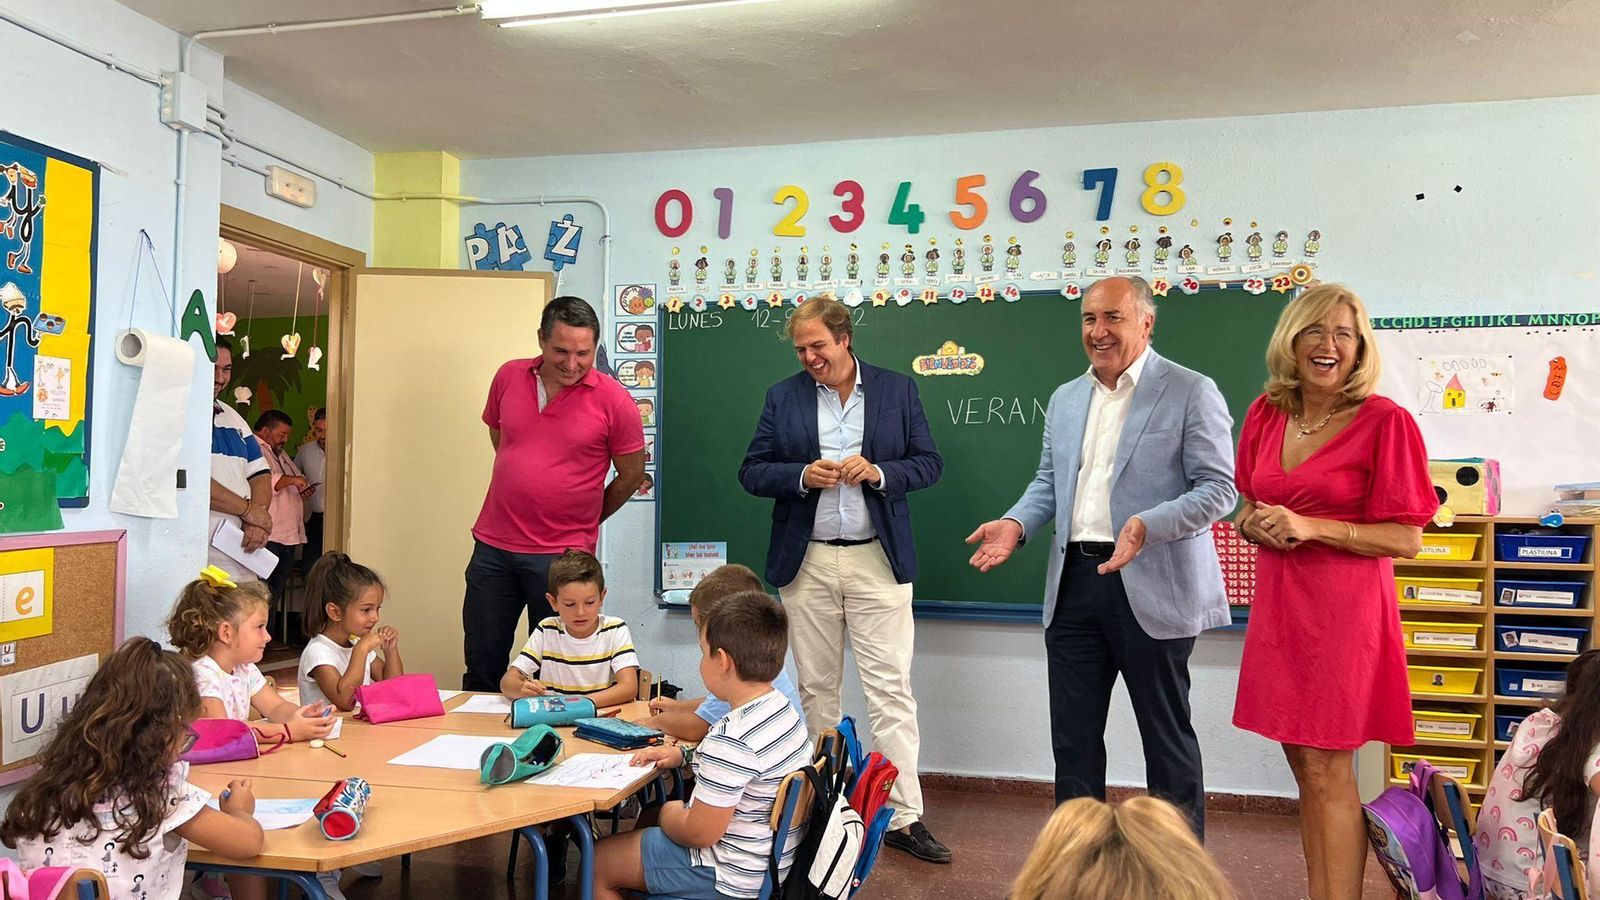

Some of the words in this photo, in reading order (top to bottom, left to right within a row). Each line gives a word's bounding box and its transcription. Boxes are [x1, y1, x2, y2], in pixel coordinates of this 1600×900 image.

[655, 189, 693, 238] 0
[713, 187, 734, 240] 1
[773, 184, 809, 237] 2
[829, 180, 865, 233] 3
[888, 182, 925, 234] 4
[950, 174, 988, 230] 5
[1009, 170, 1047, 223] 6
[1084, 168, 1117, 221] 7
[1141, 162, 1186, 216] 8
[1154, 280, 1167, 291] 19
[1183, 278, 1198, 290] 20
[1248, 279, 1263, 289] 22
[1274, 277, 1290, 288] 23
[925, 291, 934, 299] 11
[952, 290, 964, 298] 12
[980, 288, 991, 298] 13
[1005, 287, 1017, 298] 14
[1066, 285, 1078, 295] 16
[696, 298, 703, 307] 2
[724, 296, 730, 304] 3
[771, 294, 778, 302] 5
[672, 300, 678, 308] 1
[669, 311, 723, 330] LUNES
[181, 289, 217, 363] A
[16, 586, 34, 615] e
[21, 692, 45, 734] U
